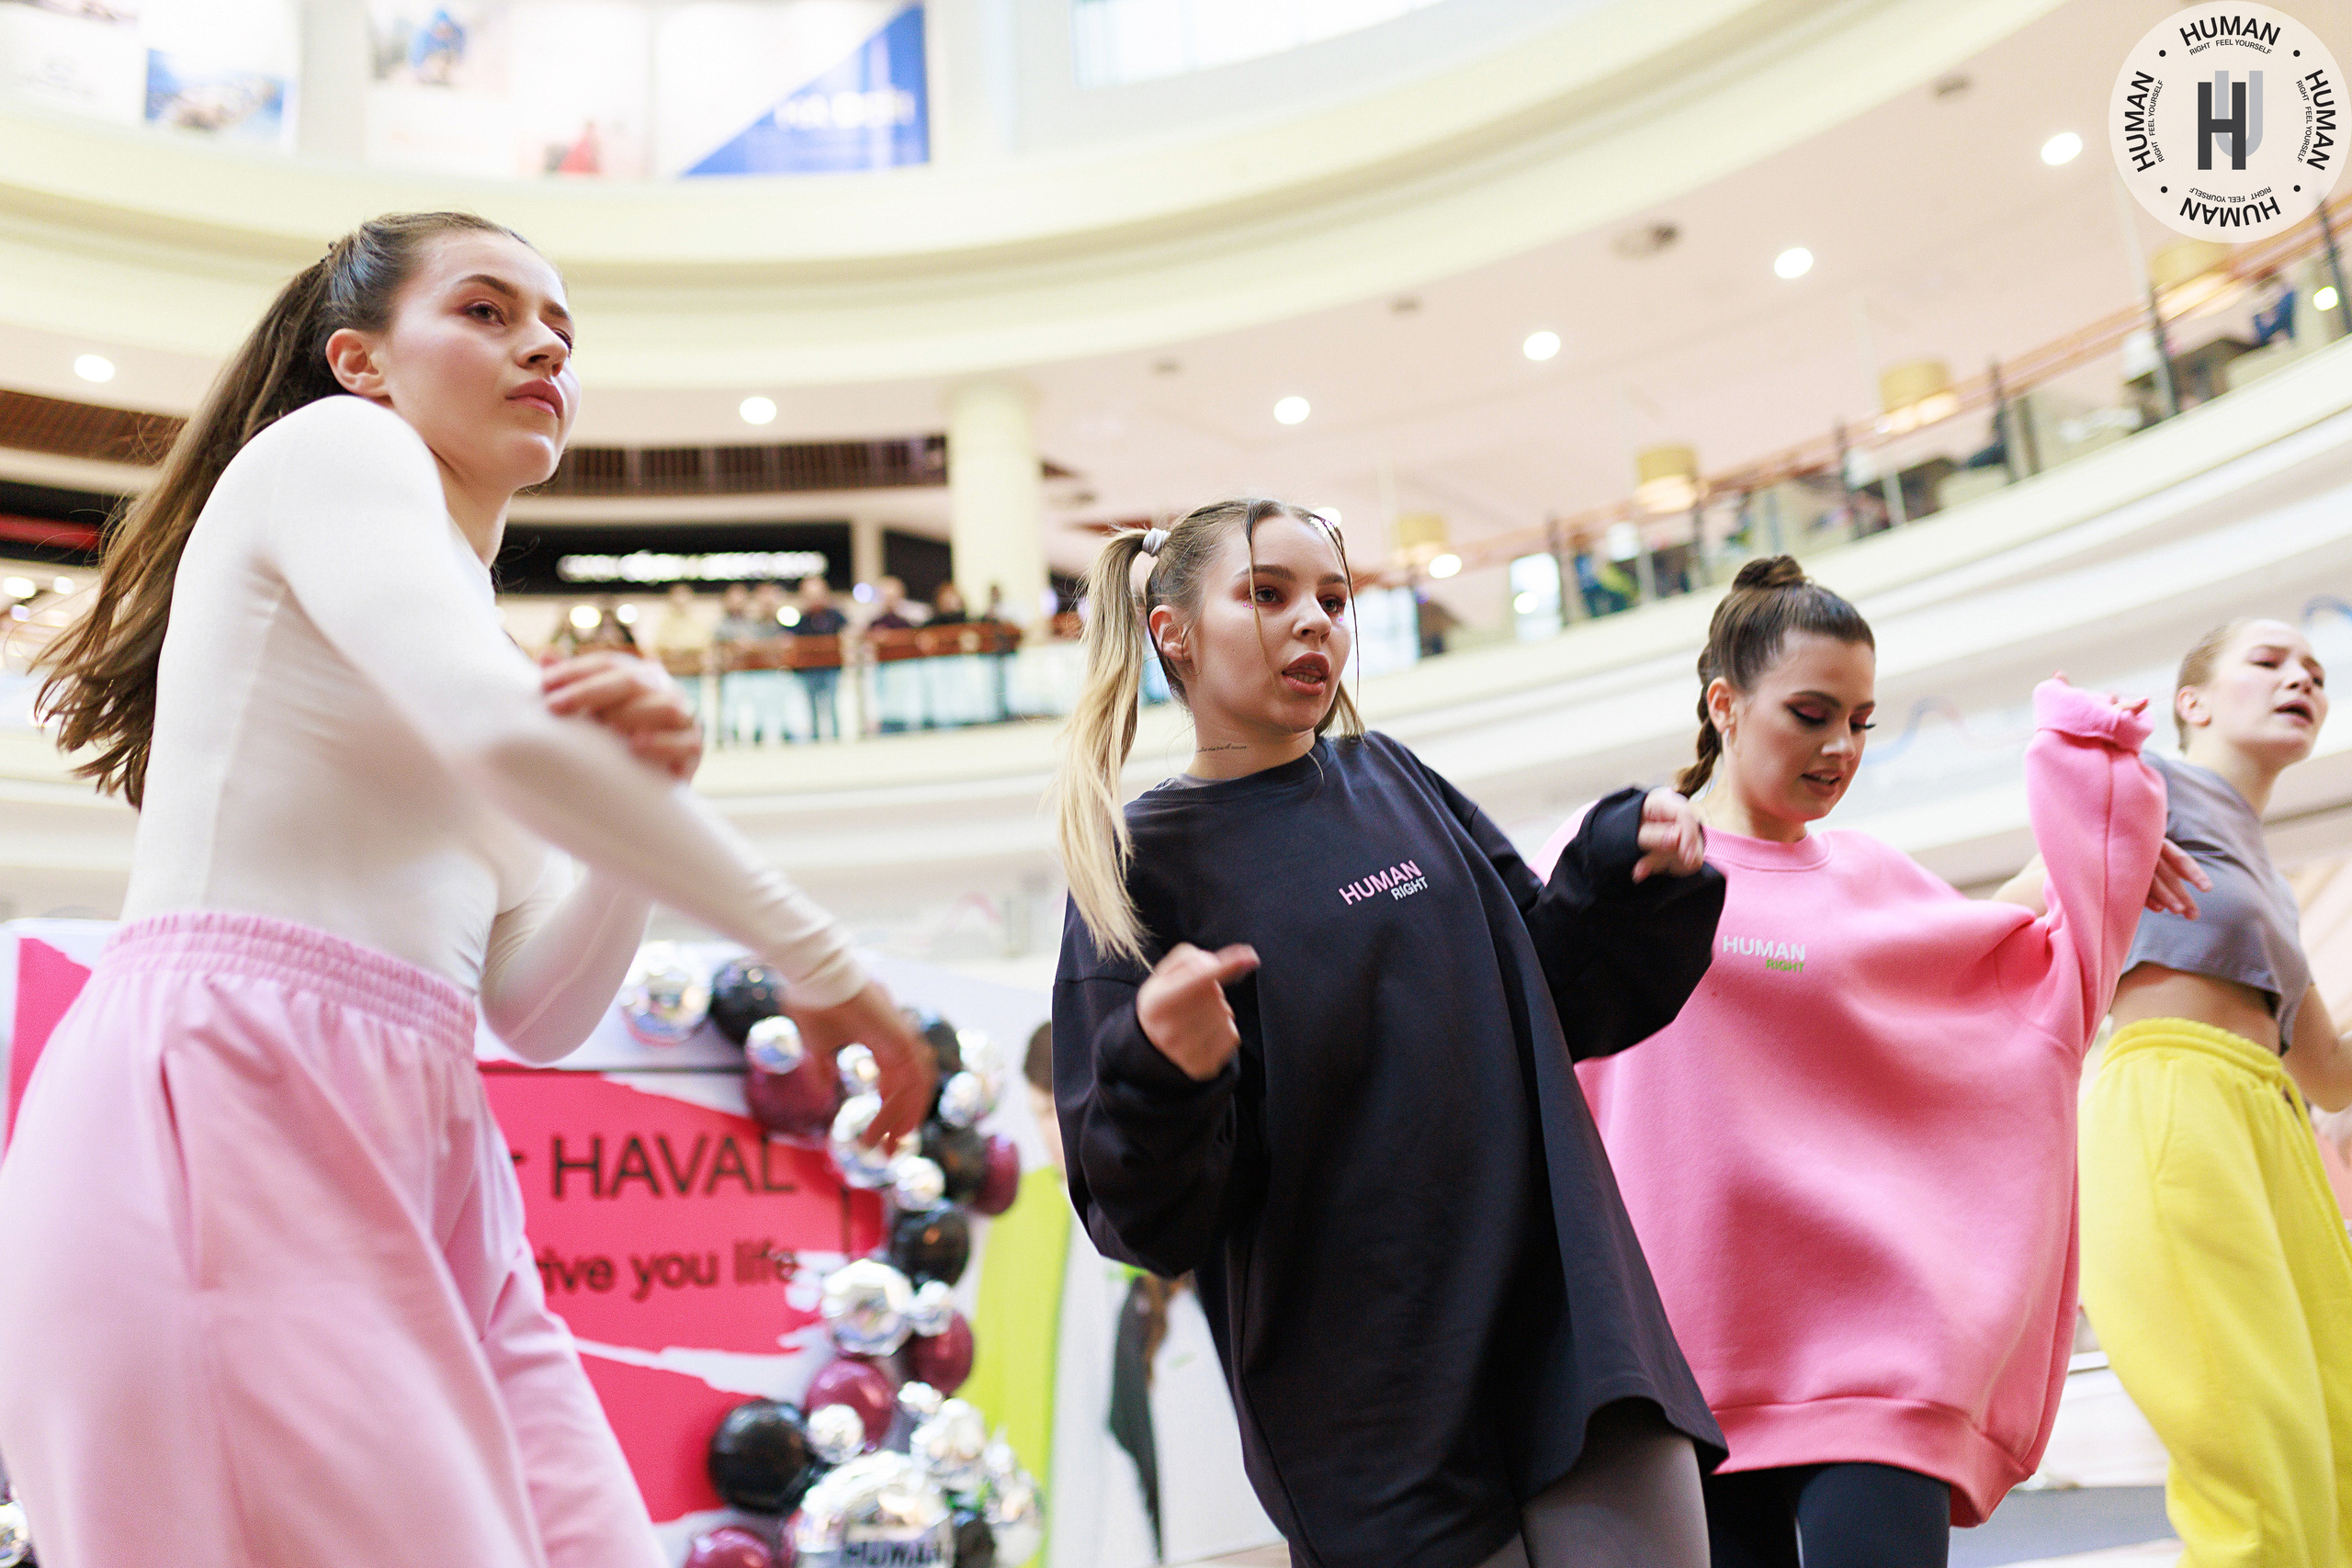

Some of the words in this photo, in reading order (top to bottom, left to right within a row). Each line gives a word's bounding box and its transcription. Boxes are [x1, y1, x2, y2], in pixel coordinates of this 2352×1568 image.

[1339, 860, 1422, 906] HUMAN
[1390, 876, 1429, 901] RIGHT
[1723, 934, 1805, 962] HUMAN
[1766, 959, 1804, 973] RIGHT
[552, 1134, 797, 1198] HAVAL
[629, 1252, 718, 1301] you
